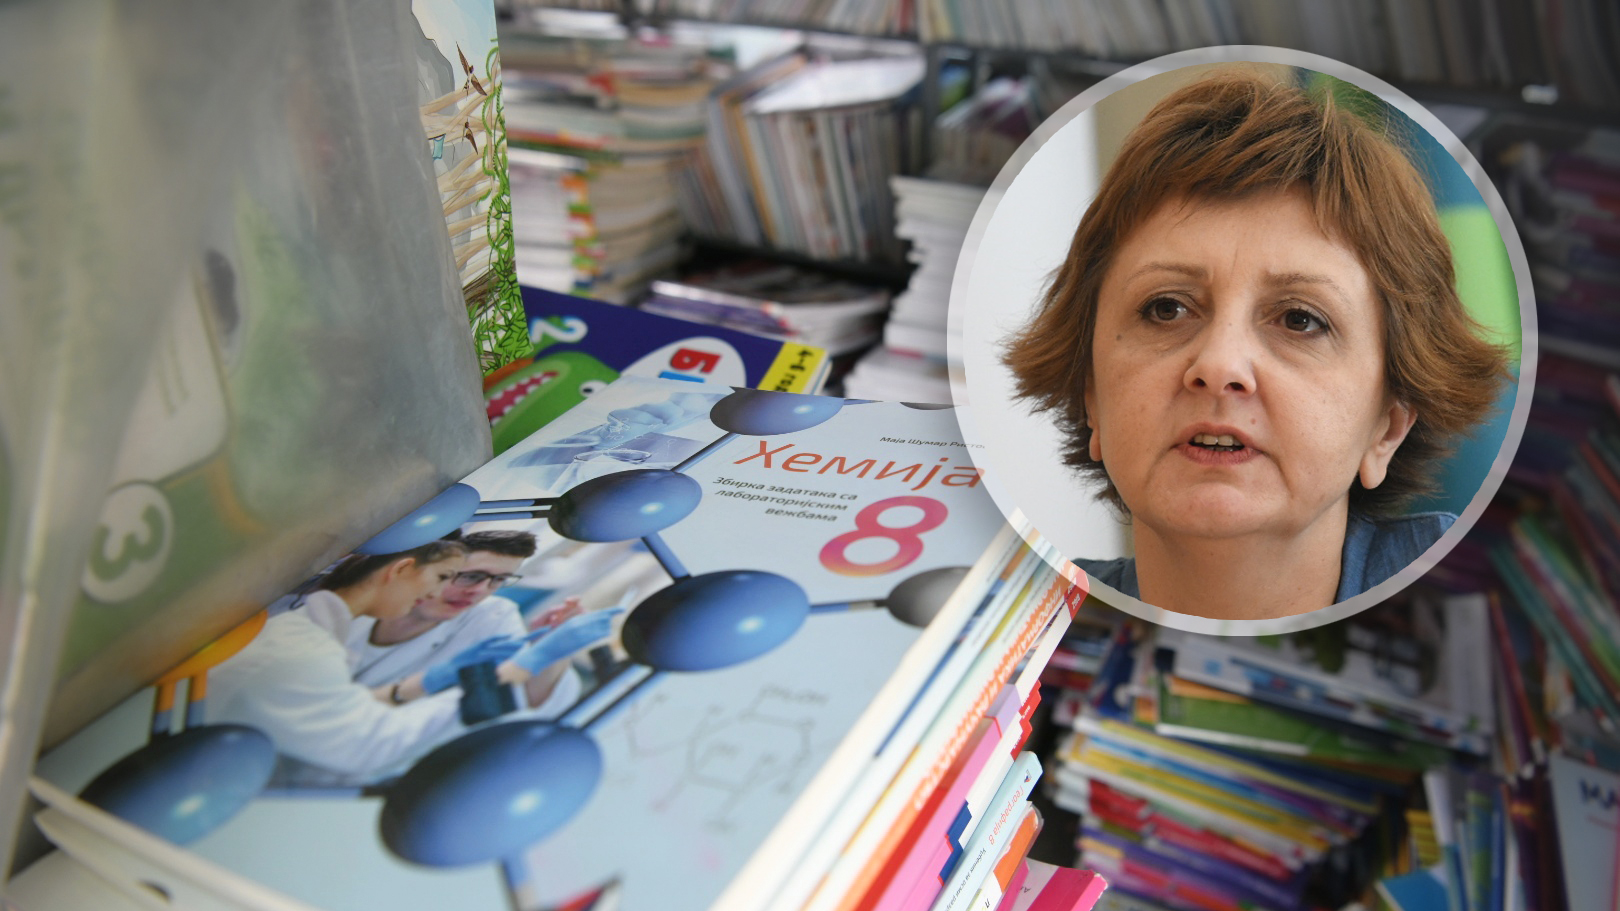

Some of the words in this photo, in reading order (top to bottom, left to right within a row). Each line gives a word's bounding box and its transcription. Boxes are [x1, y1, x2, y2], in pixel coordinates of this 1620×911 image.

[879, 436, 906, 444] Маја
[907, 438, 947, 447] Шумар
[732, 440, 986, 491] Хемија
[712, 476, 765, 491] Збирка
[766, 485, 837, 499] задатака
[839, 492, 858, 501] са
[714, 488, 849, 511] лабораторијским
[765, 506, 838, 522] вежбама
[818, 495, 949, 577] 8
[991, 786, 1024, 835] Географија
[988, 834, 996, 846] 8
